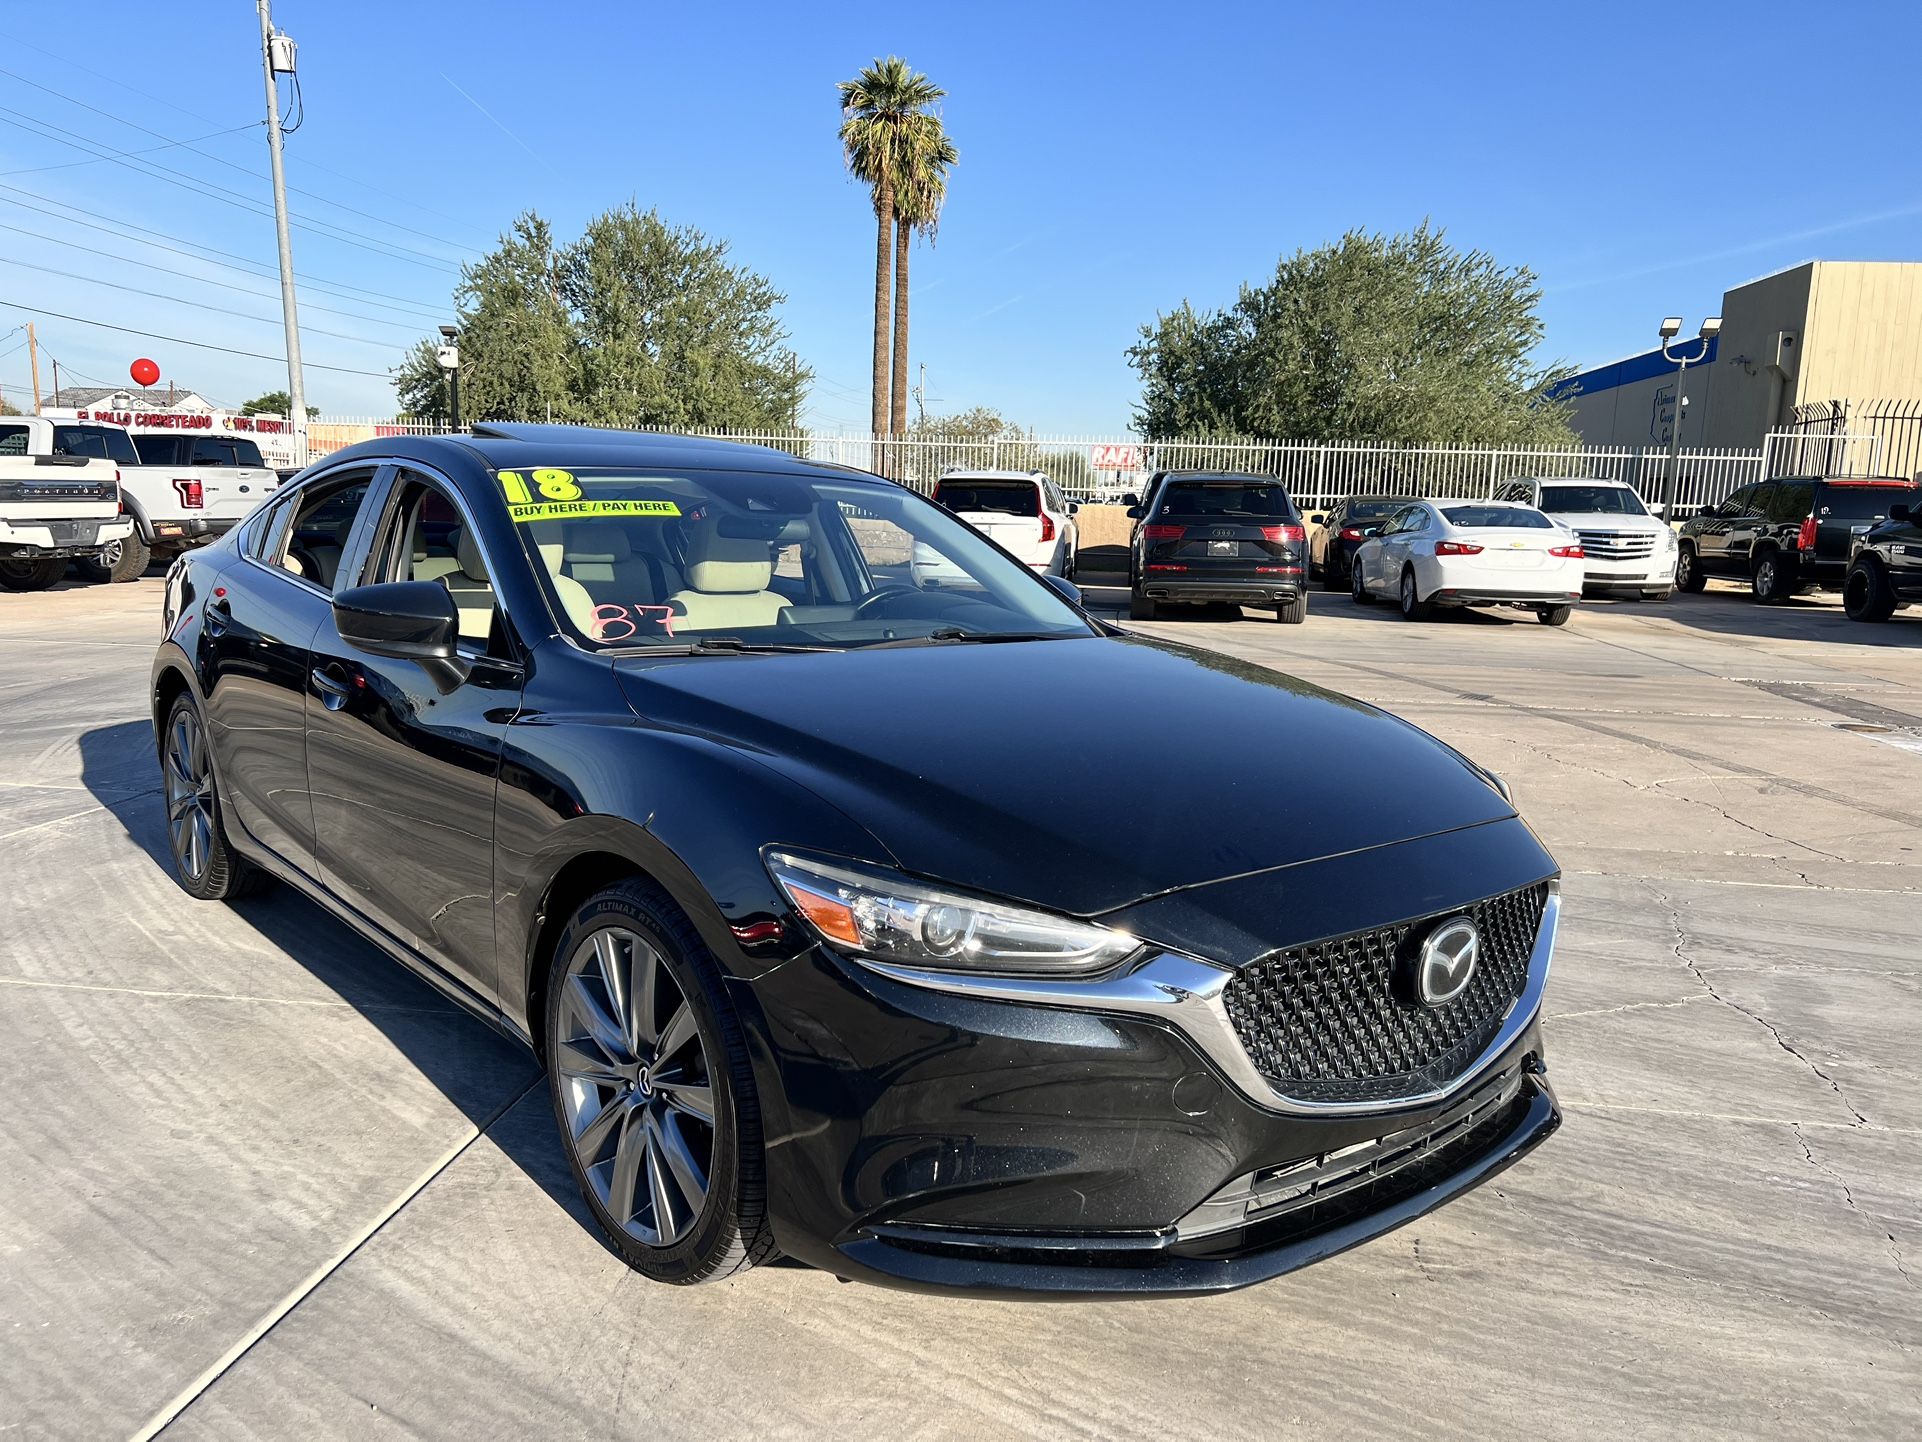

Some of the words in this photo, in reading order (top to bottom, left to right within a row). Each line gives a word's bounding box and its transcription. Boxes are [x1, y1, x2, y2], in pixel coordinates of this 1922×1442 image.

[95, 411, 132, 427] POLLO
[497, 469, 582, 504] 18
[514, 506, 543, 517] BUY
[549, 503, 588, 513] HERE
[602, 502, 629, 512] PAY
[634, 502, 673, 511] HERE
[590, 604, 689, 645] 87
[596, 902, 636, 917] ALTIMAX
